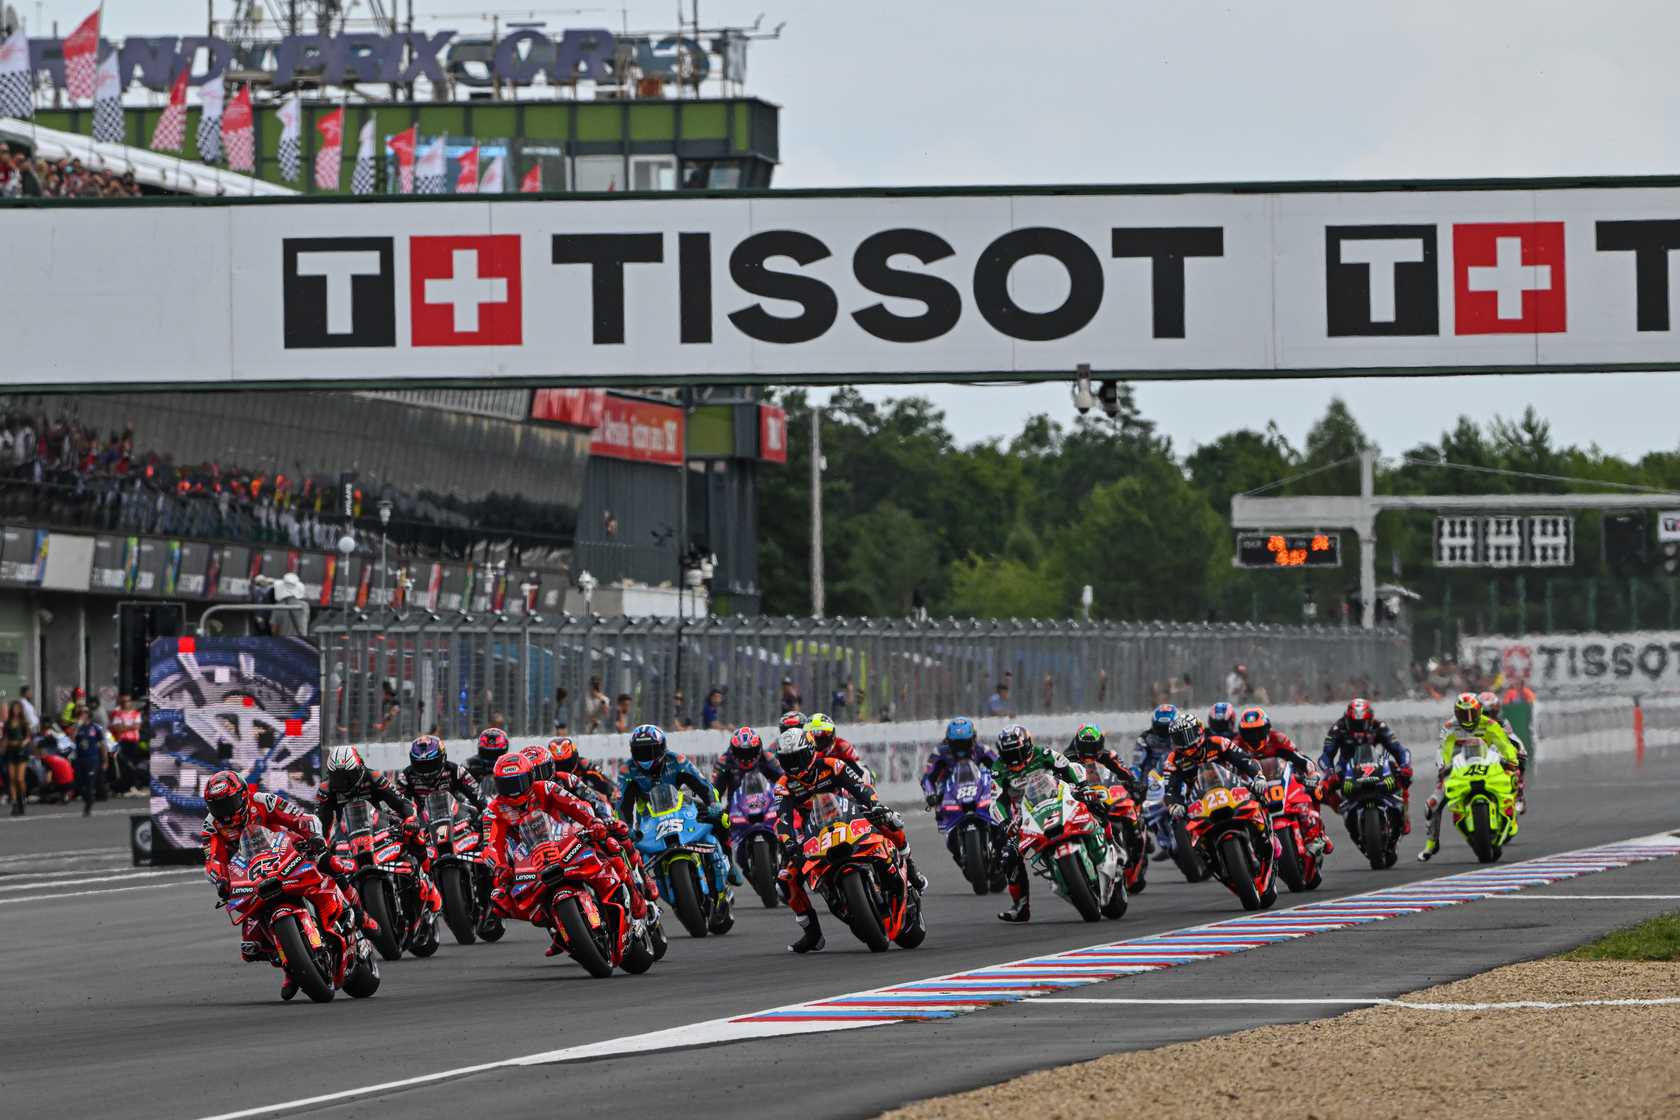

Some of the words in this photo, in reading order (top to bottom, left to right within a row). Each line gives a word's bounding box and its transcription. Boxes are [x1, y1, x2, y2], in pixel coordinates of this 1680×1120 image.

[552, 227, 1223, 345] TISSOT
[956, 785, 978, 800] 88
[1206, 789, 1229, 809] 23
[655, 818, 684, 841] 25
[530, 844, 561, 870] 93
[561, 843, 582, 863] Lenovo
[280, 855, 303, 876] Lenovo
[515, 873, 537, 881] Lenovo
[231, 886, 254, 895] Lenovo
